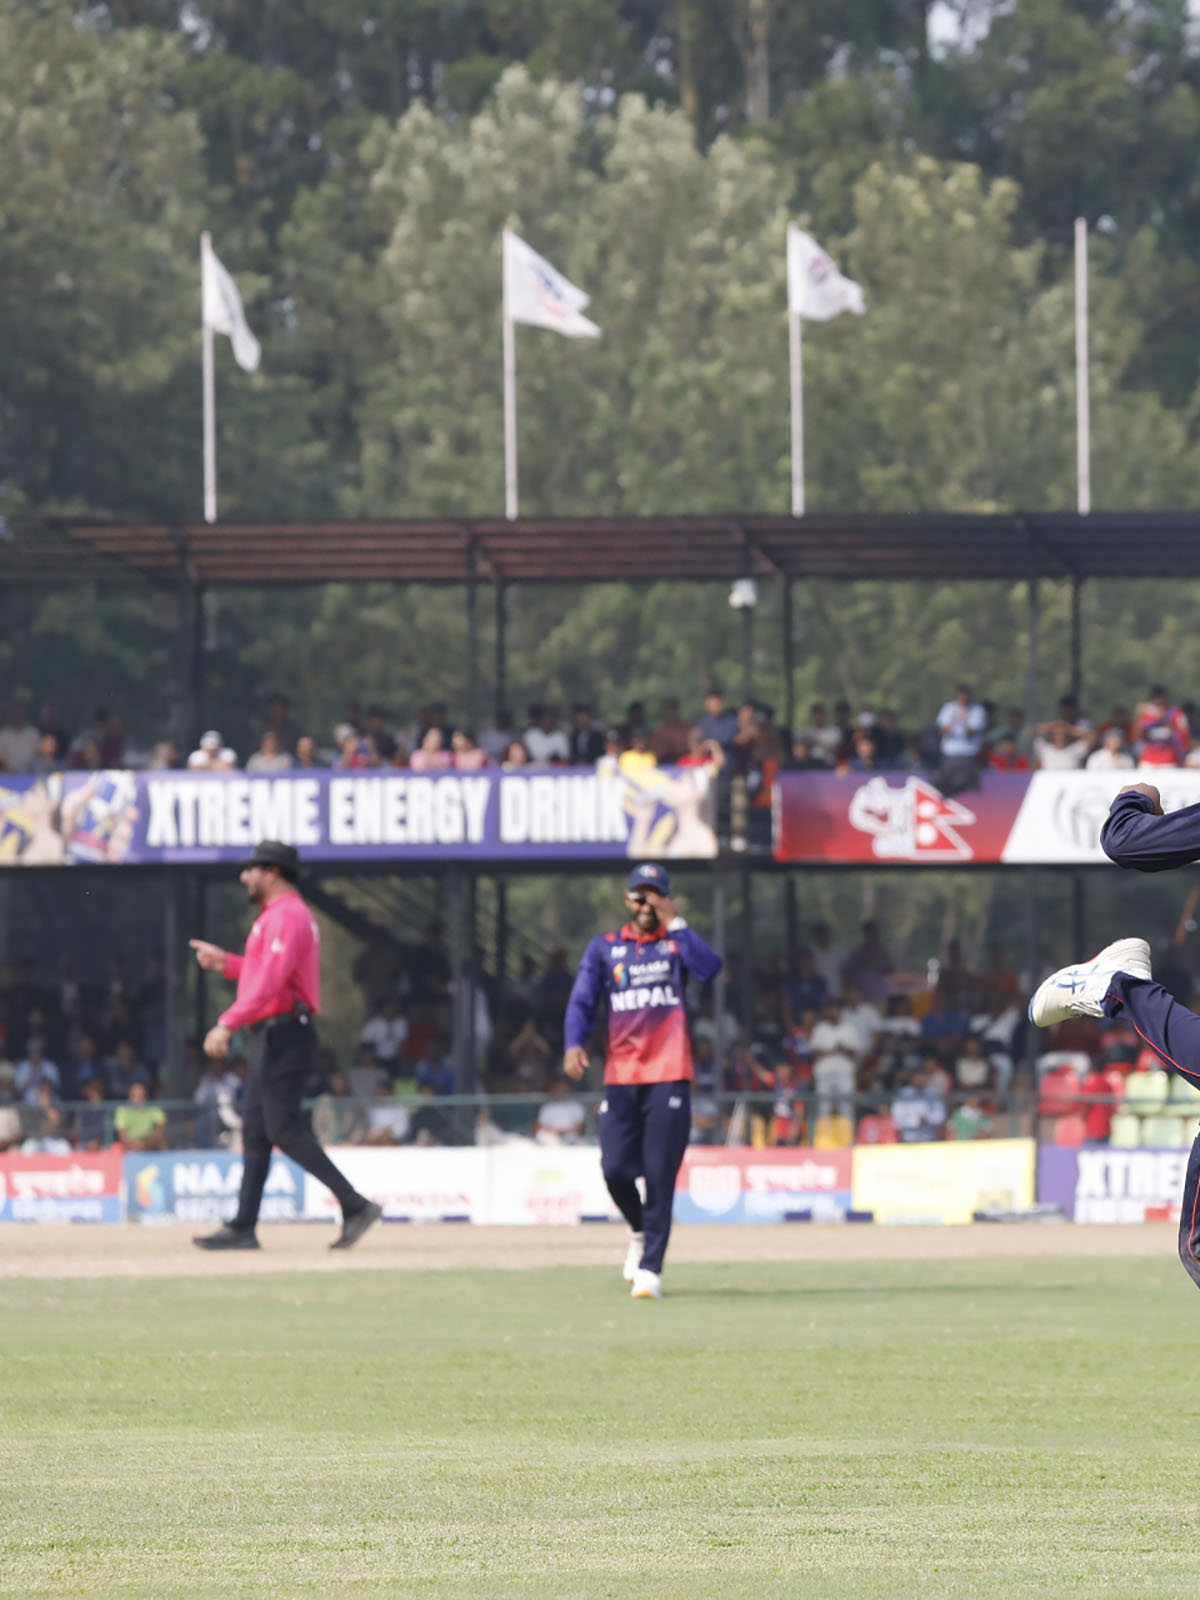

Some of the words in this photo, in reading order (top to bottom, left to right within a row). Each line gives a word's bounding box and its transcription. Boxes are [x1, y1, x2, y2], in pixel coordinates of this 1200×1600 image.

[147, 778, 320, 846] XTREME
[330, 777, 491, 844] ENERGY
[501, 775, 628, 842] DRINK
[611, 985, 680, 1012] NEPAL
[173, 1162, 296, 1195] NAAA
[1076, 1150, 1191, 1198] XTRE
